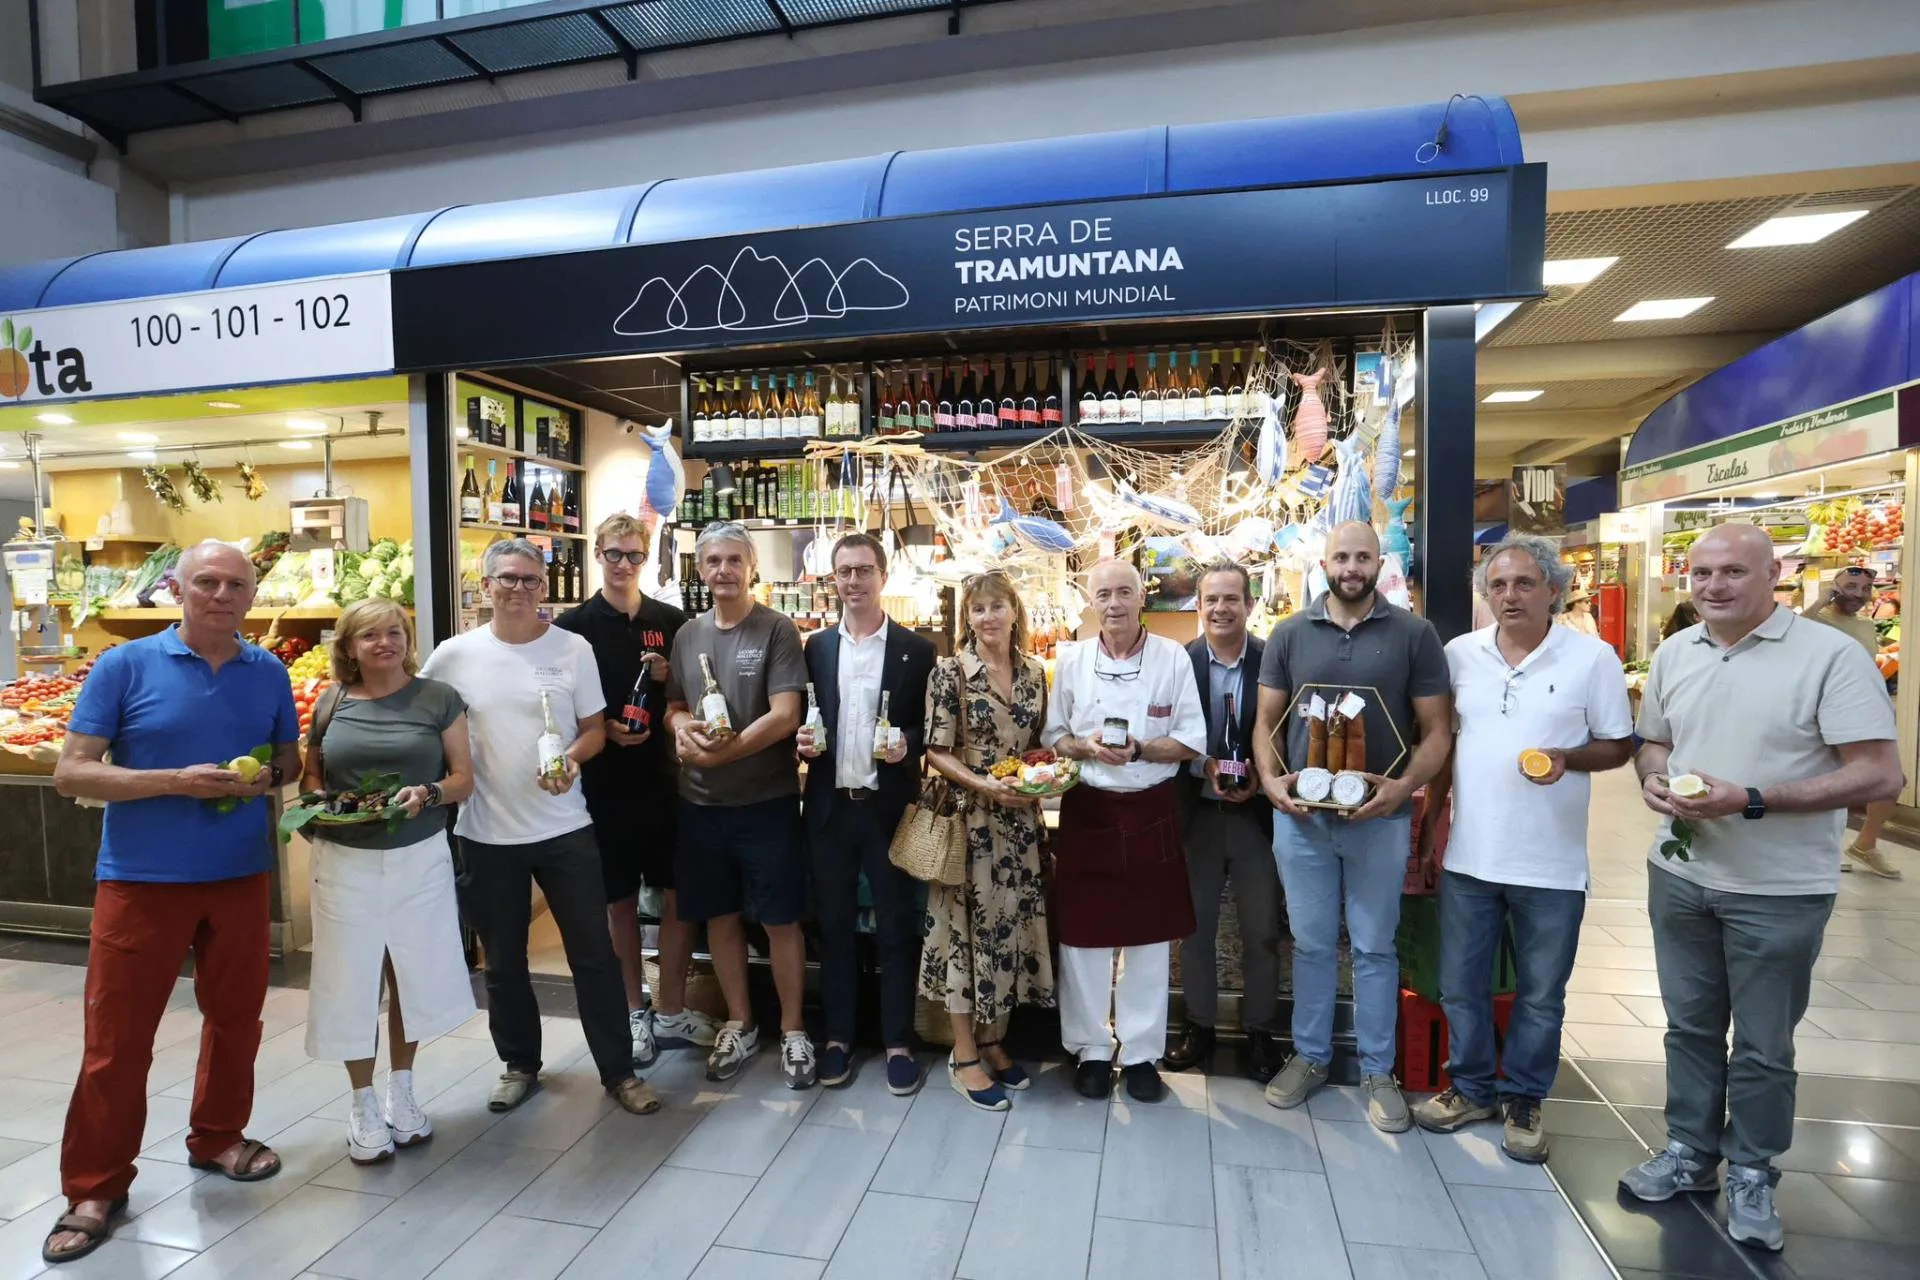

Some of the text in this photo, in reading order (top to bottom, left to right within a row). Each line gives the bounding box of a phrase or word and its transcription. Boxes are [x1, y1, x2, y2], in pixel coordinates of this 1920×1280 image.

[1470, 188, 1489, 202] 99
[954, 217, 1112, 251] SERRA DE
[954, 246, 1184, 284] TRAMUNTANA
[954, 284, 1176, 313] PATRIMONI MUNDIAL
[130, 313, 182, 347] 100
[211, 304, 259, 339] 101
[295, 293, 350, 331] 102
[1522, 469, 1554, 502] VIDA
